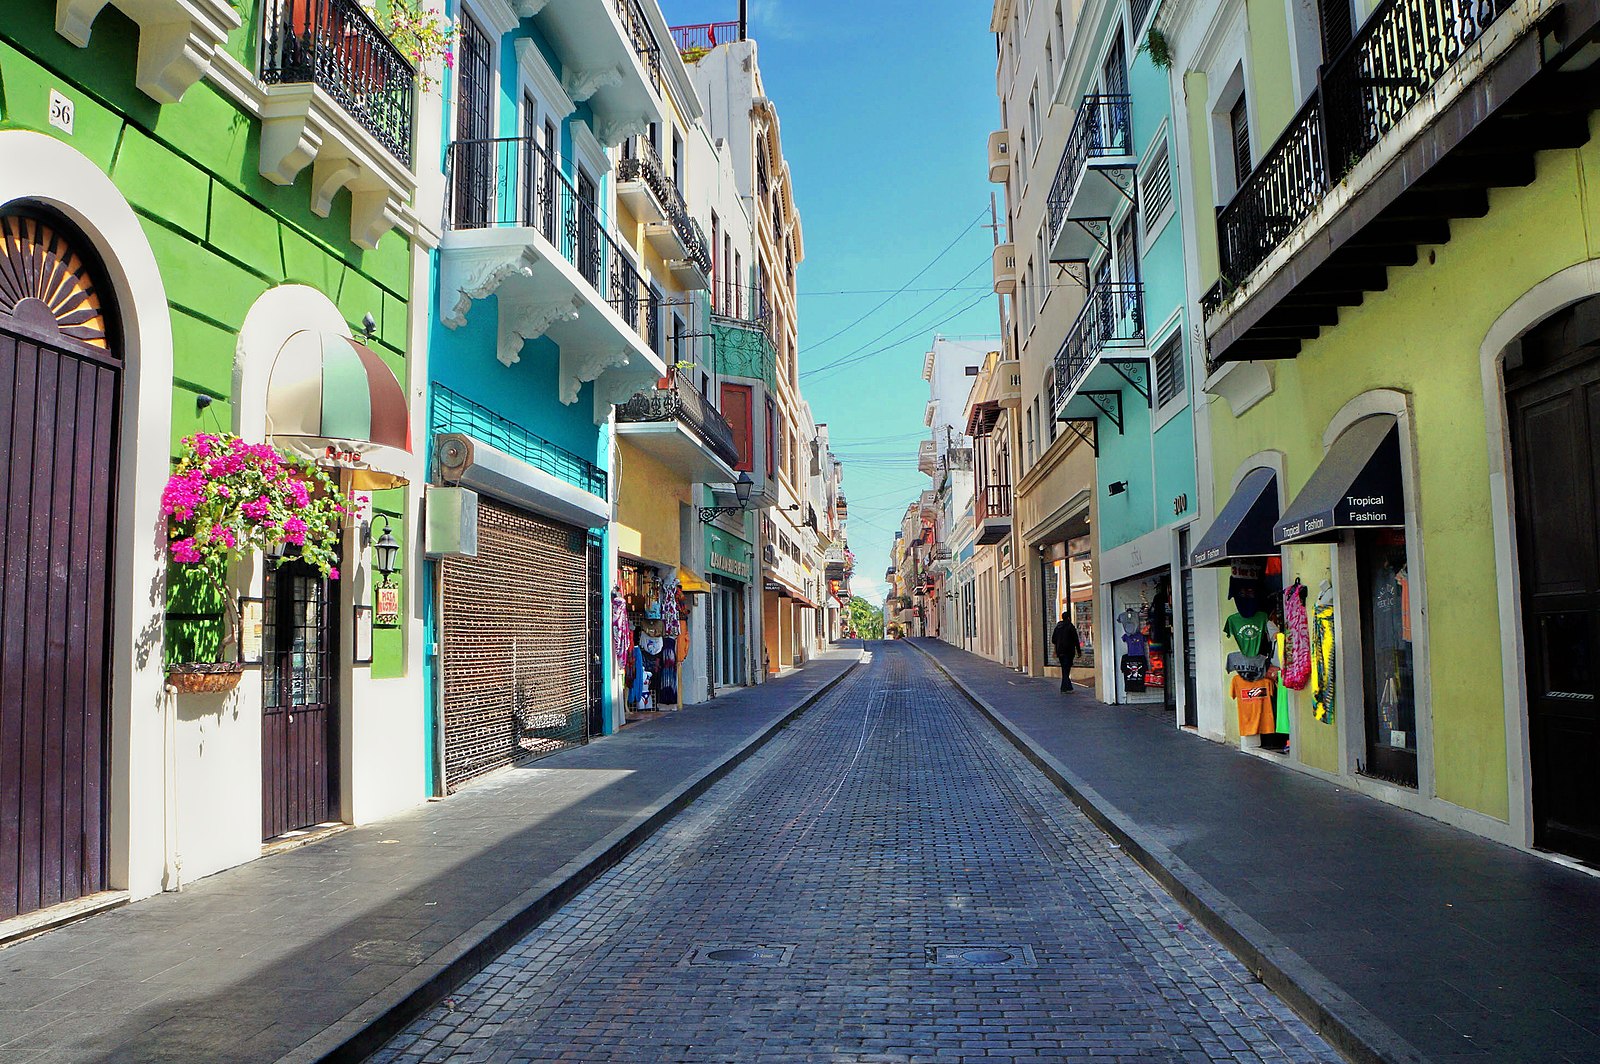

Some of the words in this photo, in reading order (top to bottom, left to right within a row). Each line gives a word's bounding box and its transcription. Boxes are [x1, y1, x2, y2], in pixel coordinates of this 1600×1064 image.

[51, 99, 70, 125] 56
[1346, 496, 1384, 507] Tropical
[1349, 512, 1387, 521] Fashion
[1282, 523, 1300, 538] Tropical
[1304, 518, 1324, 531] Fashion
